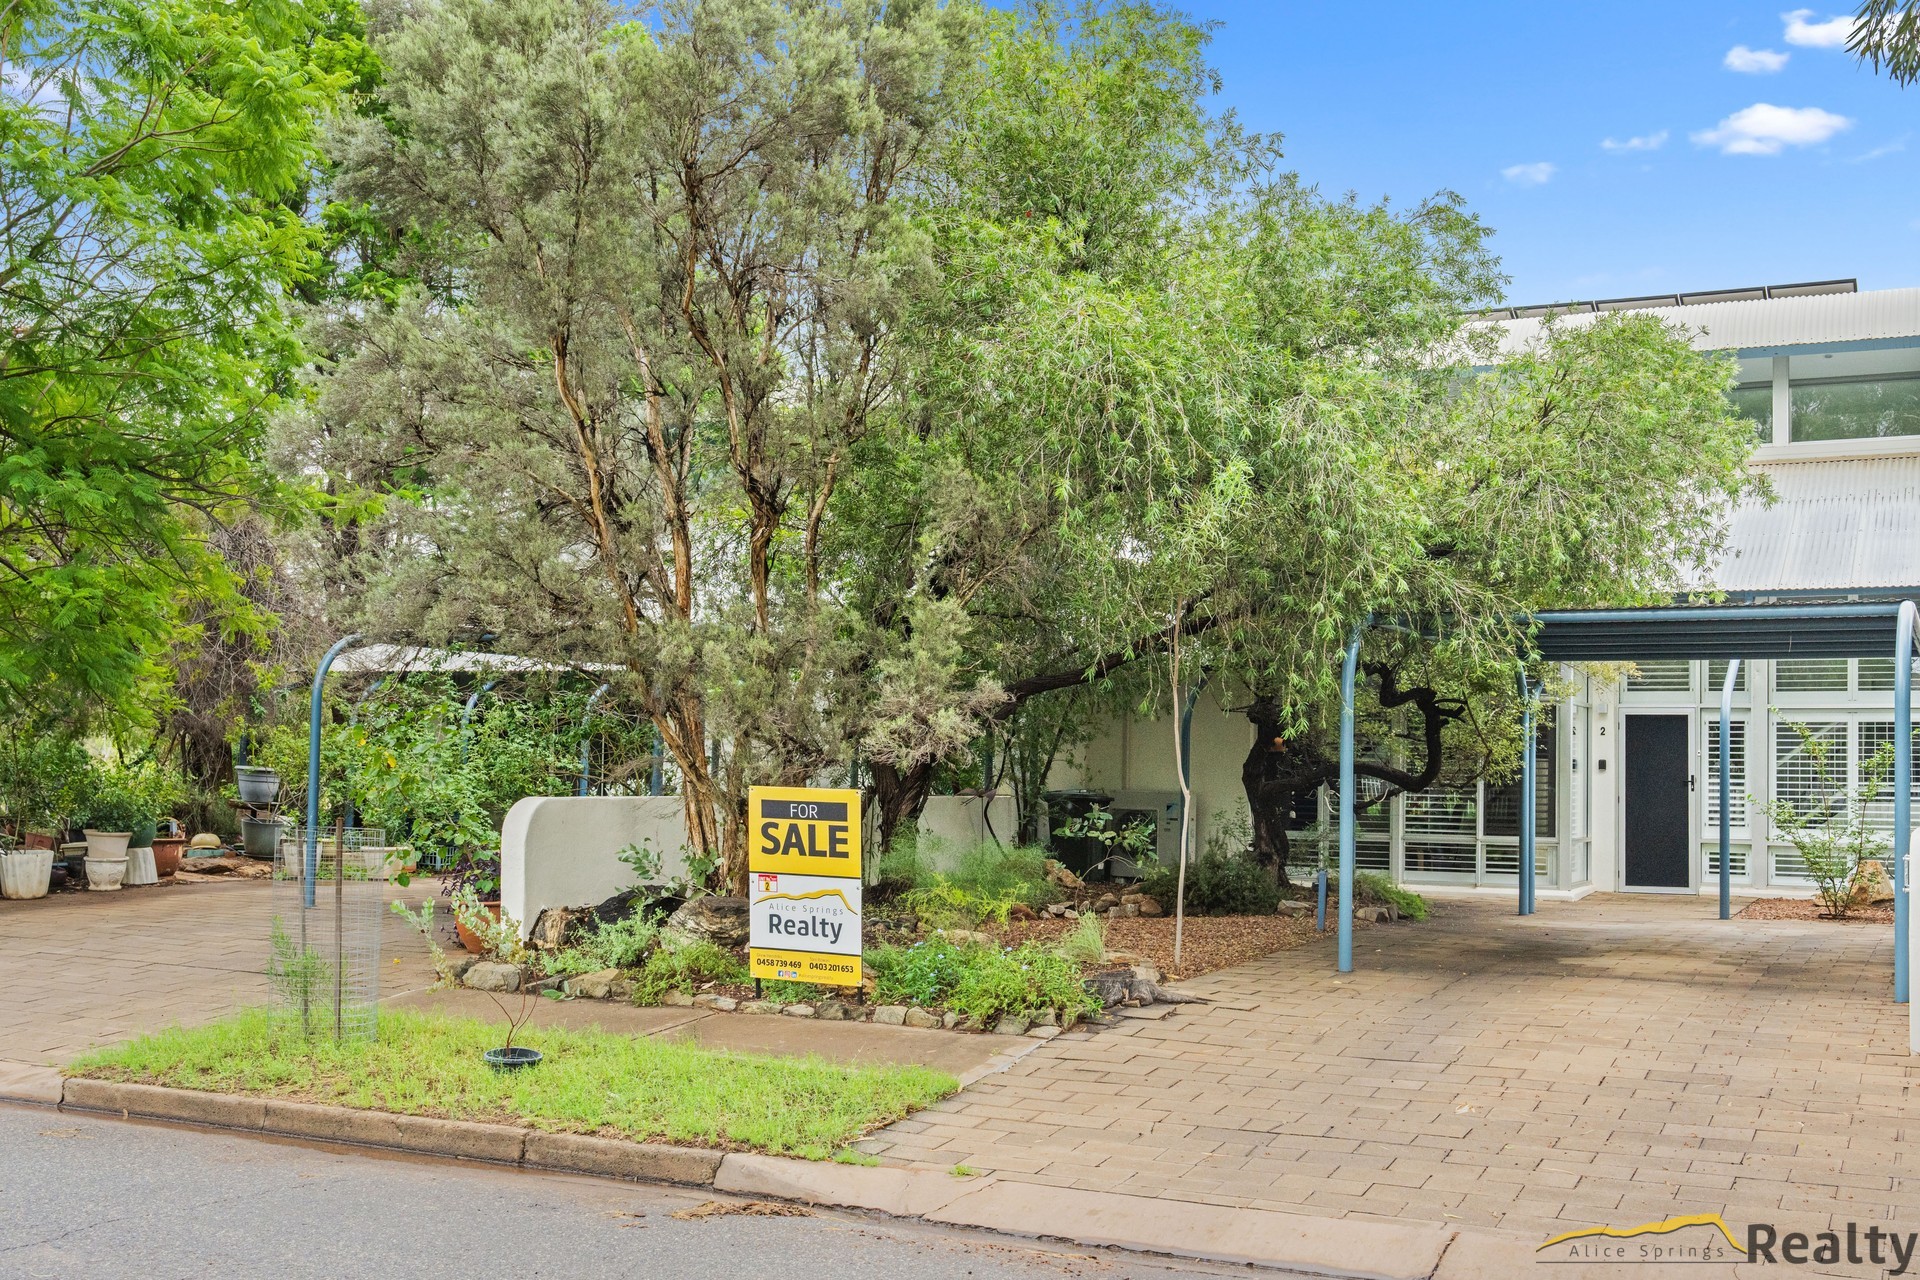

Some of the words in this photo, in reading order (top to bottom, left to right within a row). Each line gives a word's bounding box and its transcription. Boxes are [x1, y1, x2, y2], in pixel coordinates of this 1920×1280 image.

[1600, 726, 1606, 736] 2
[789, 803, 818, 819] FOR
[760, 821, 850, 859] SALE
[764, 881, 771, 891] 2
[768, 902, 797, 912] Alice
[802, 904, 844, 917] Springs
[768, 913, 843, 945] Realty
[756, 958, 775, 967] 0458
[775, 959, 788, 968] 739
[788, 960, 802, 969] 469
[809, 962, 828, 971] 0403
